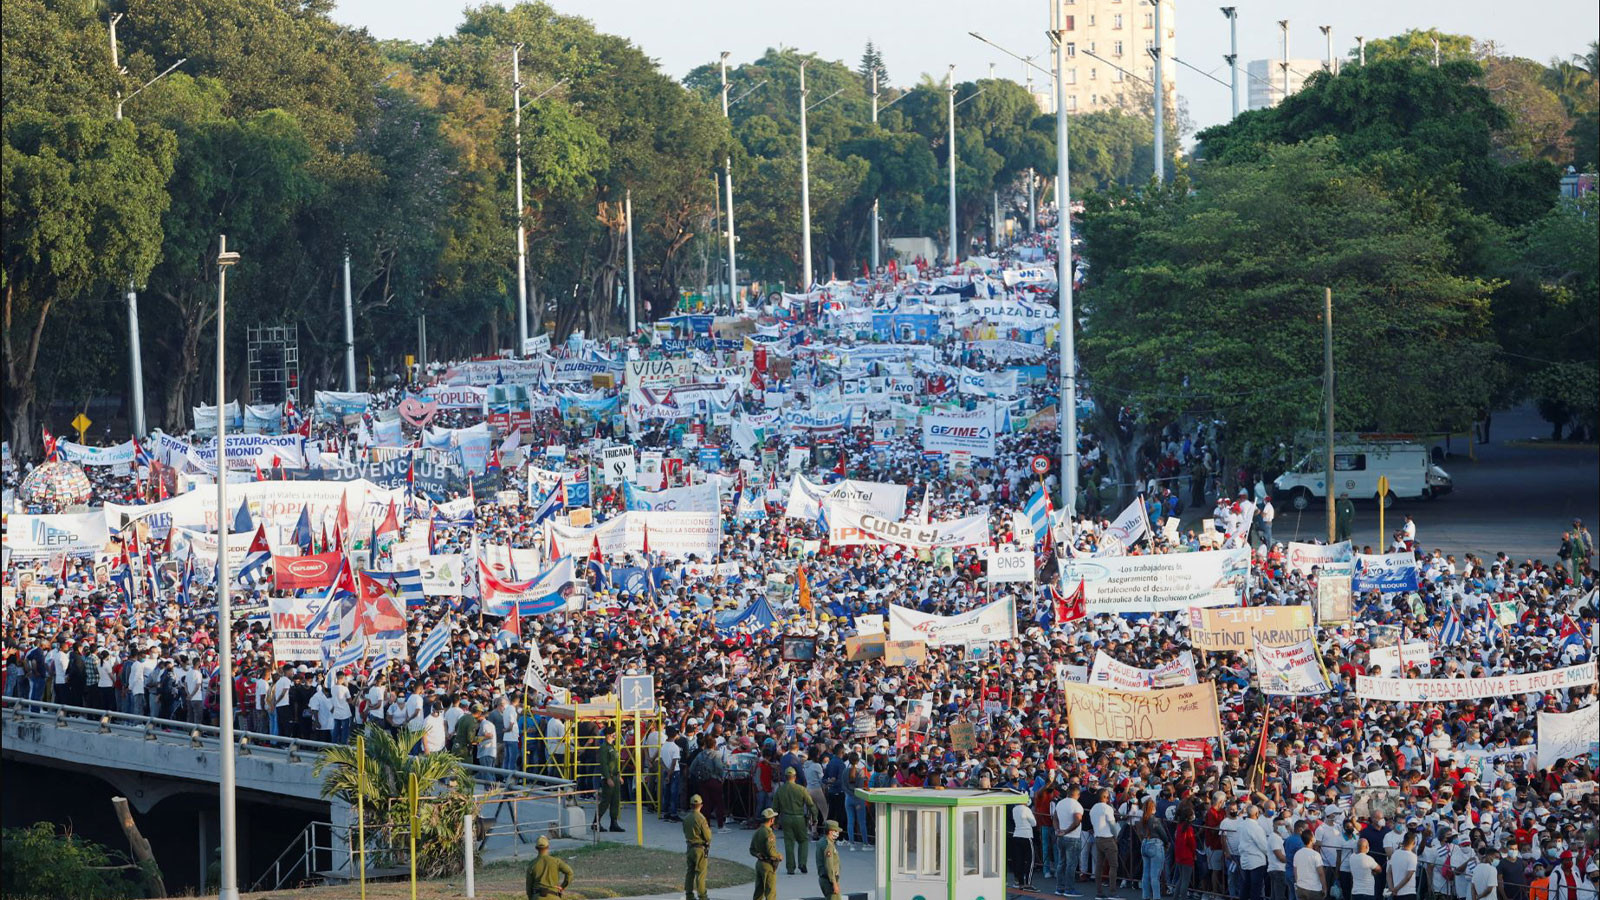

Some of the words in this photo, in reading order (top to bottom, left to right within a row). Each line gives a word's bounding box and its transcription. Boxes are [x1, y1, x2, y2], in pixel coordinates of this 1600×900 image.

[984, 307, 1023, 316] PLAZA
[665, 340, 685, 351] SAN
[633, 362, 674, 376] VIVA
[605, 447, 632, 458] TRICANA
[1035, 459, 1046, 467] 50
[860, 514, 912, 539] Cuba
[48, 535, 78, 545] EPP
[1107, 661, 1143, 679] ESCUELA
[1378, 681, 1400, 696] VIVE
[1509, 679, 1522, 692] EL
[1552, 671, 1564, 685] DE
